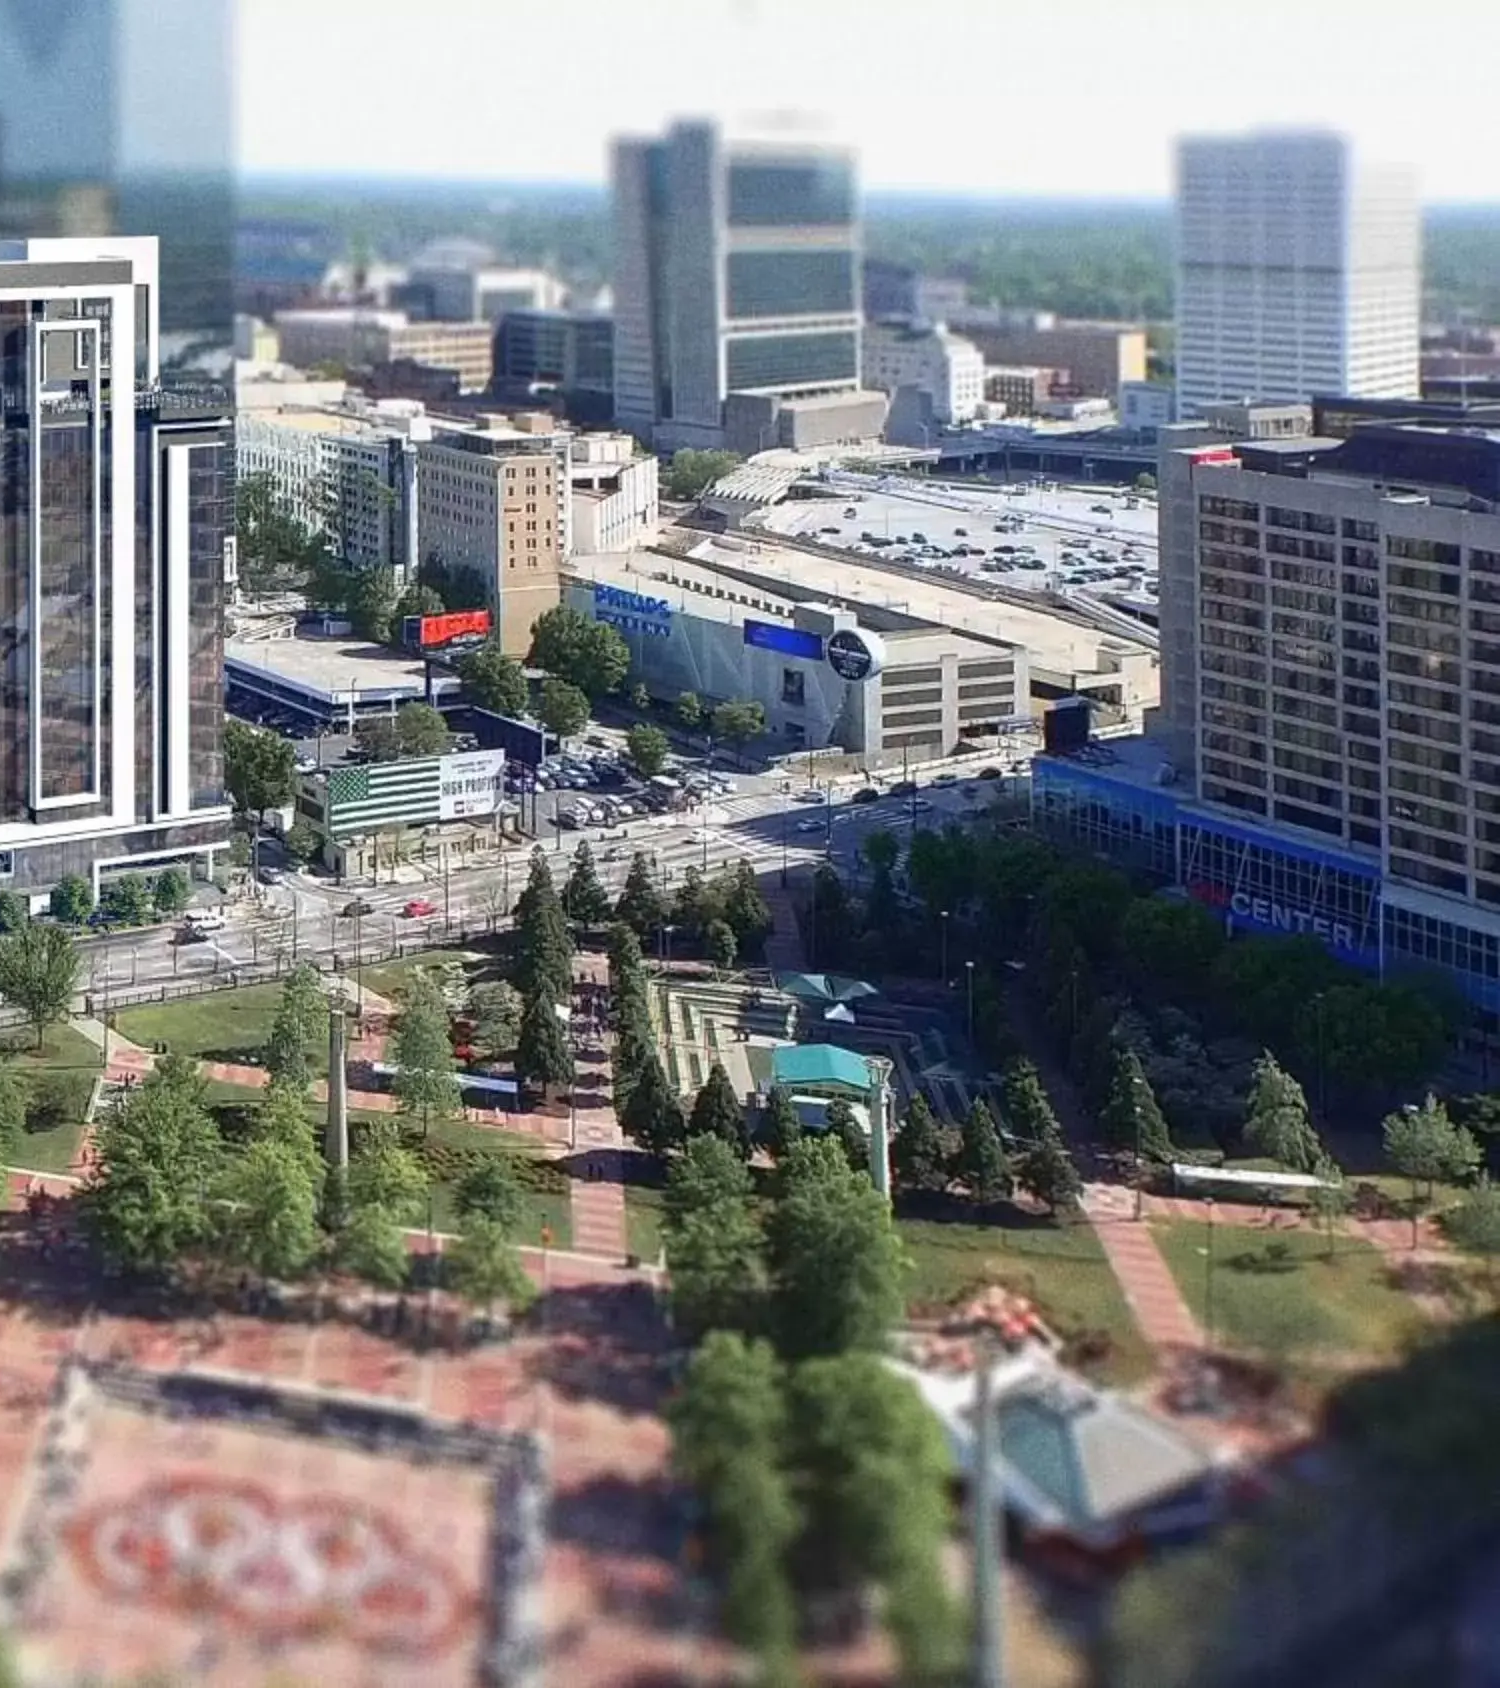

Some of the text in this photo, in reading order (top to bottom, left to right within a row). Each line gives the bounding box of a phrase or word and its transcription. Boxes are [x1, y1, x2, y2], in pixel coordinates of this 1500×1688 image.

[595, 584, 671, 618] PHILIPS
[442, 780, 462, 796] HIGH
[1230, 892, 1353, 952] CENTER
